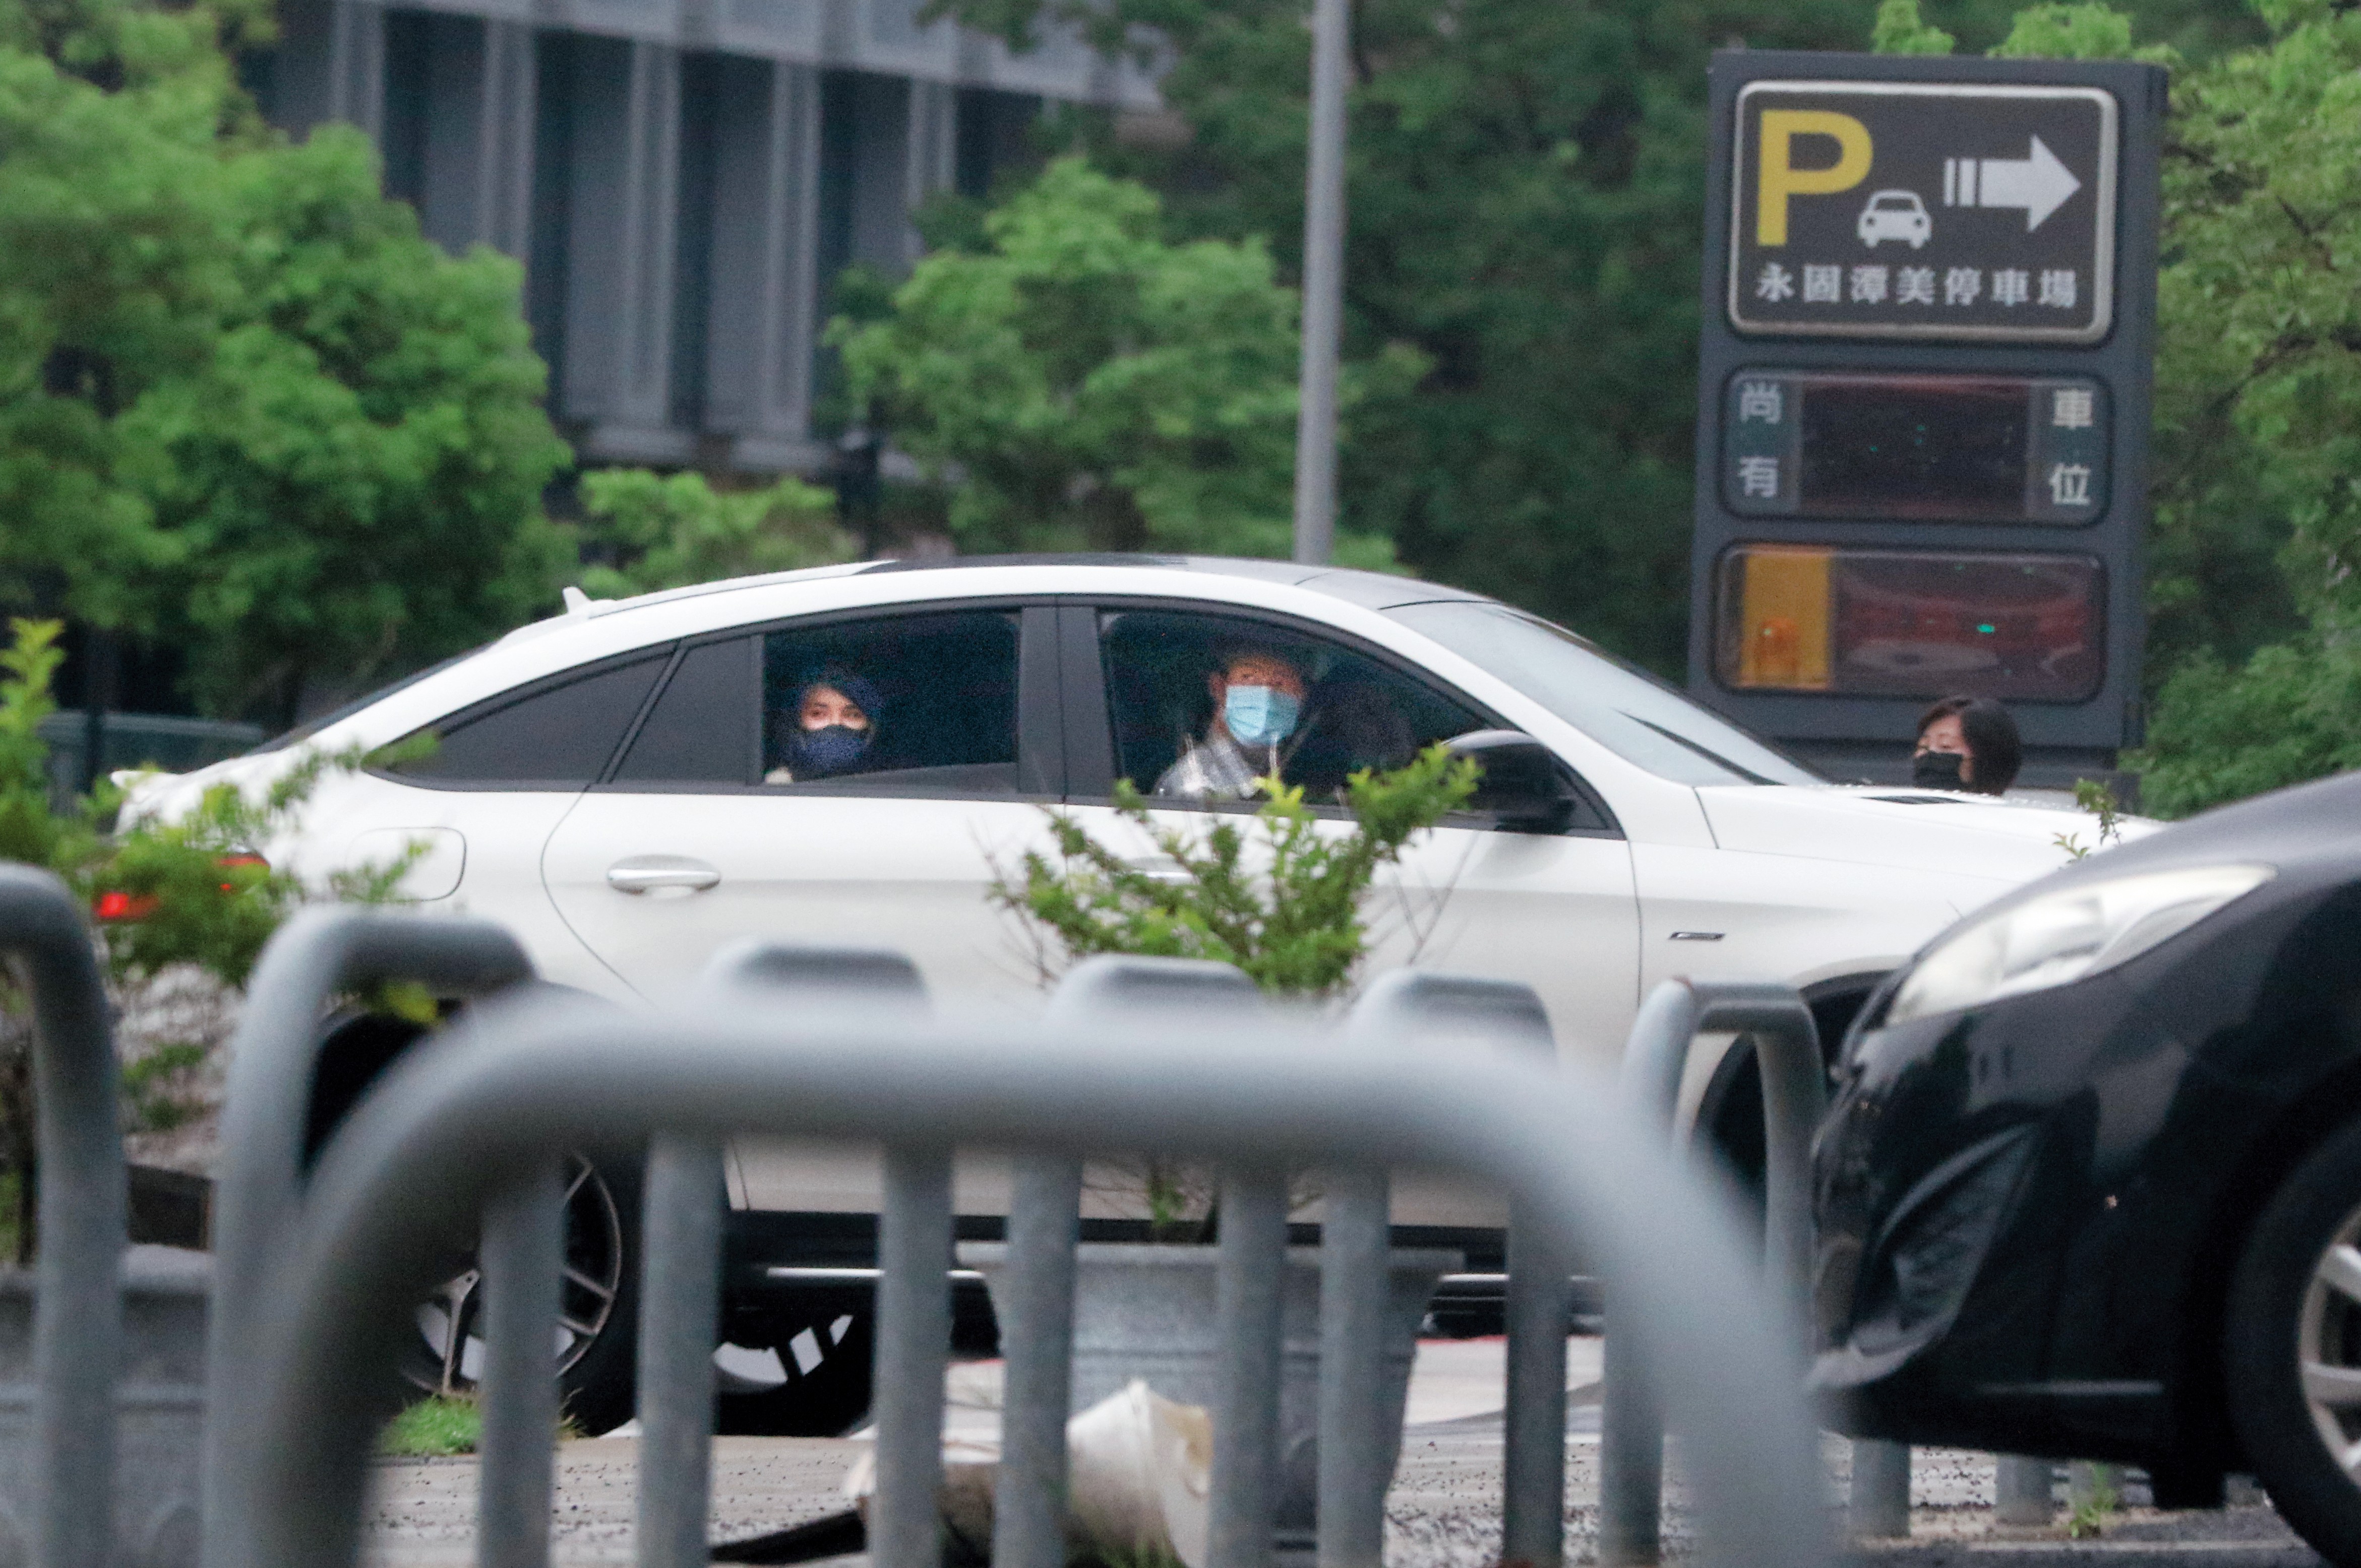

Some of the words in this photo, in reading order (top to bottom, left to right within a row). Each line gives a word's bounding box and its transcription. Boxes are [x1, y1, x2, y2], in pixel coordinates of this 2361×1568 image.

[1757, 109, 1873, 247] P
[1754, 262, 2078, 309] 永固潭美停車場
